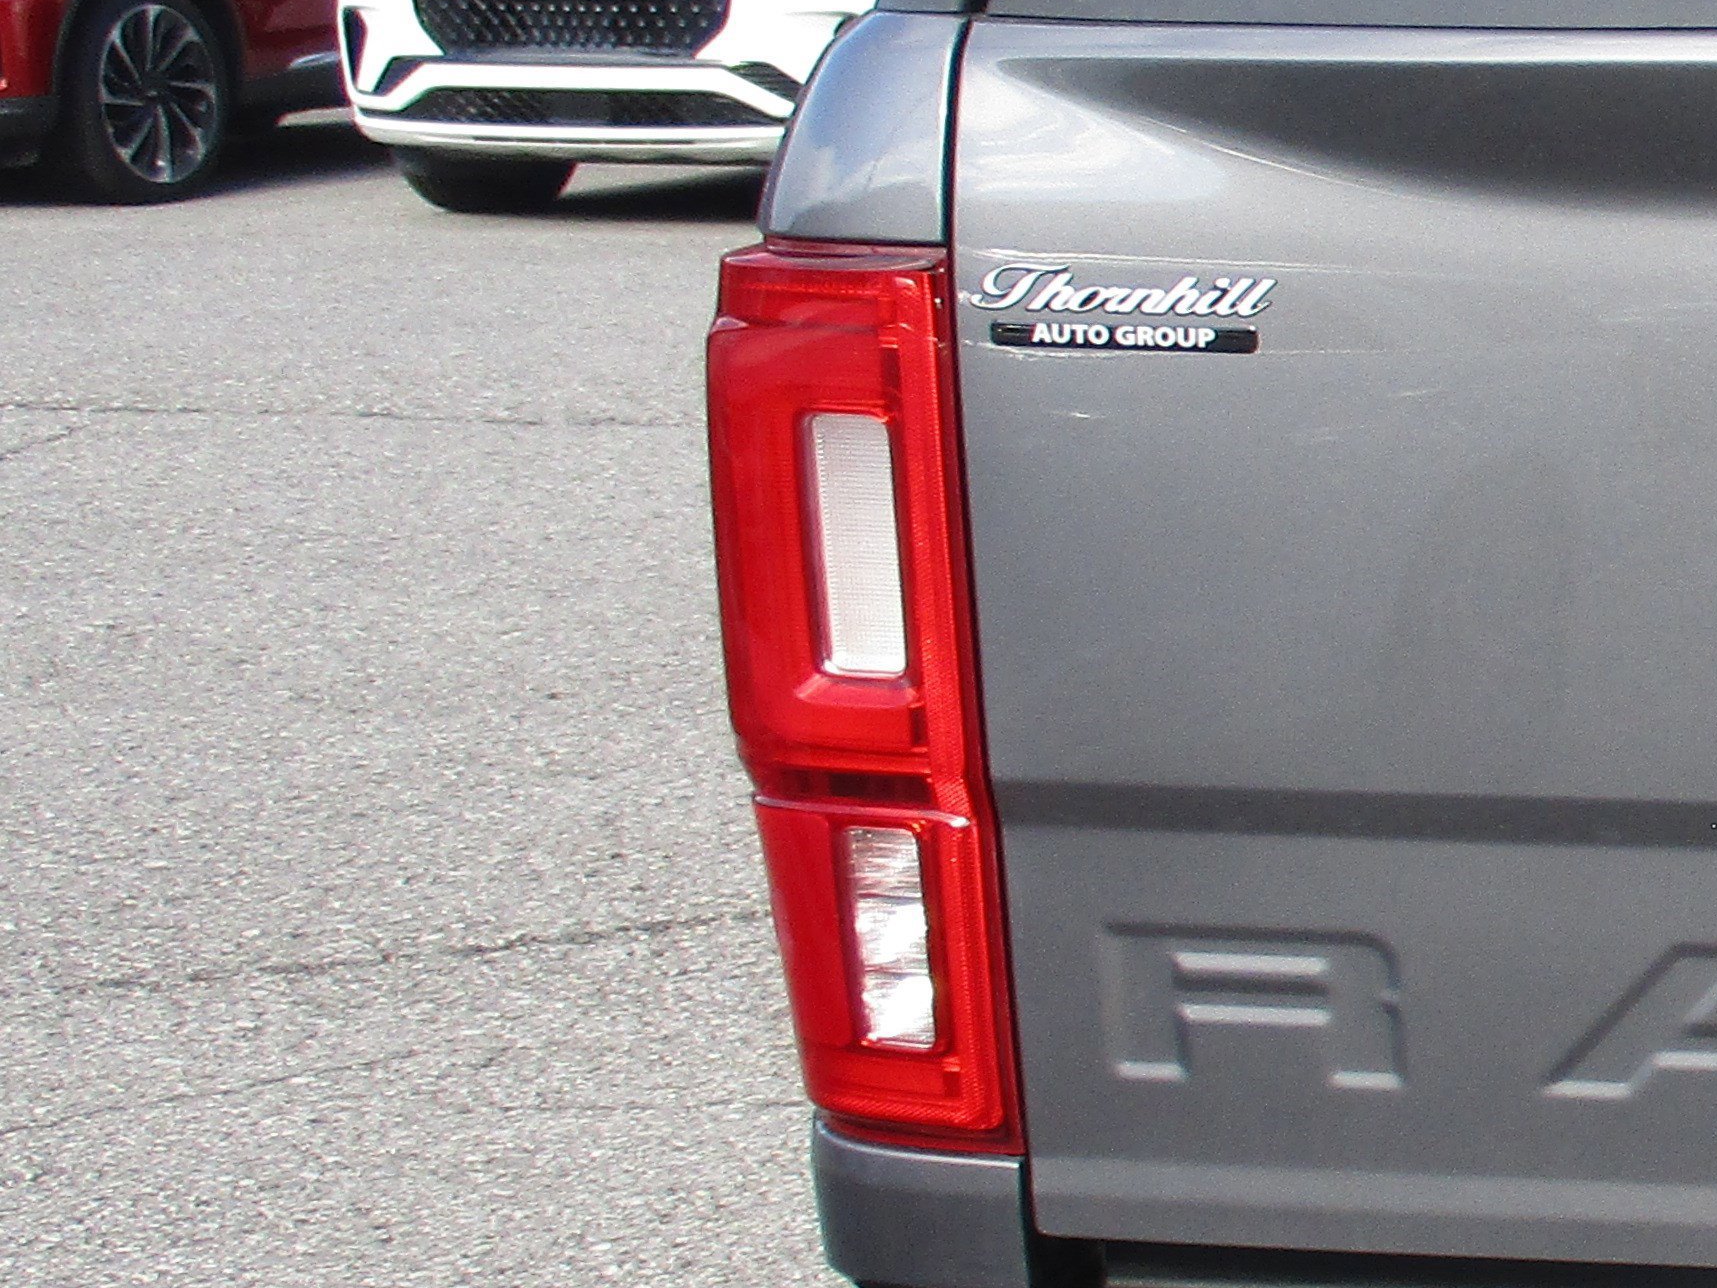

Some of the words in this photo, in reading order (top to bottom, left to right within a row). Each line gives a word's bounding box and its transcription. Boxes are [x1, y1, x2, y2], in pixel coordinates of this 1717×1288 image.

[971, 263, 1277, 318] Thornhill
[1032, 323, 1110, 346] AUTO
[1114, 325, 1217, 349] GROUP
